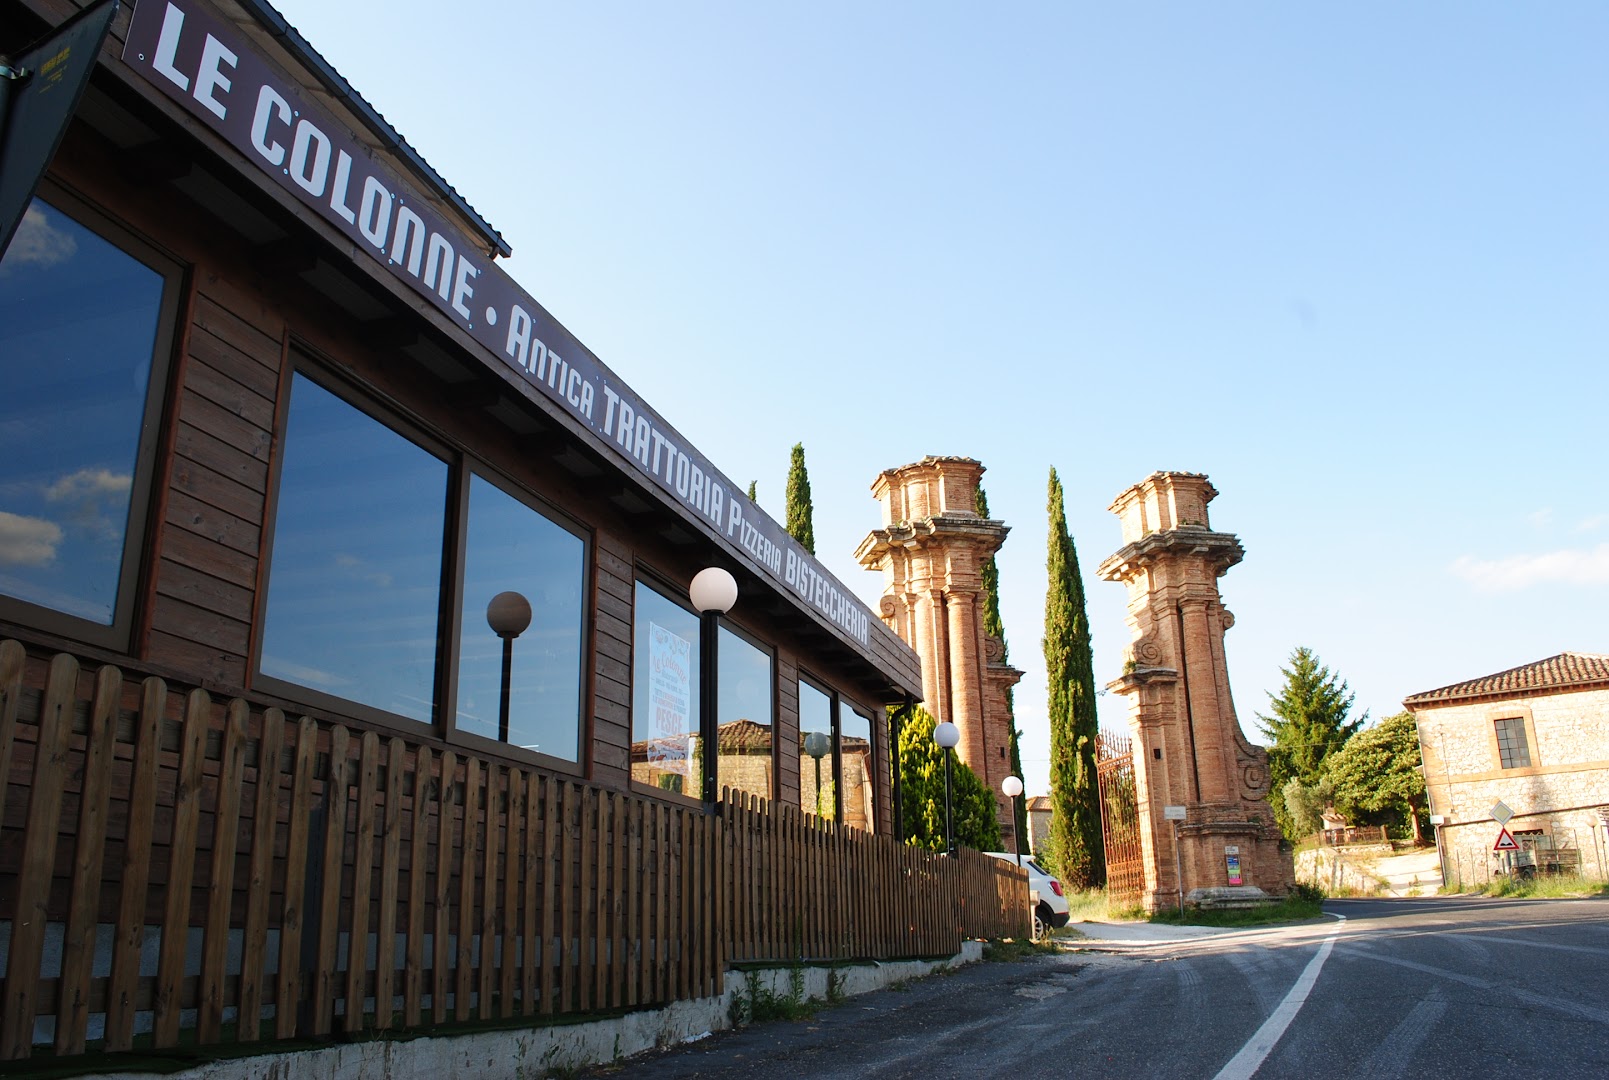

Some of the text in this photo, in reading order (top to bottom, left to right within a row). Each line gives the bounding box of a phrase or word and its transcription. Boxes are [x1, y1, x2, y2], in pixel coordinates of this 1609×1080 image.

[152, 1, 868, 646] LE COLONNE ANTICA TRATTORIA PIZZERIA BISTECCHERIA
